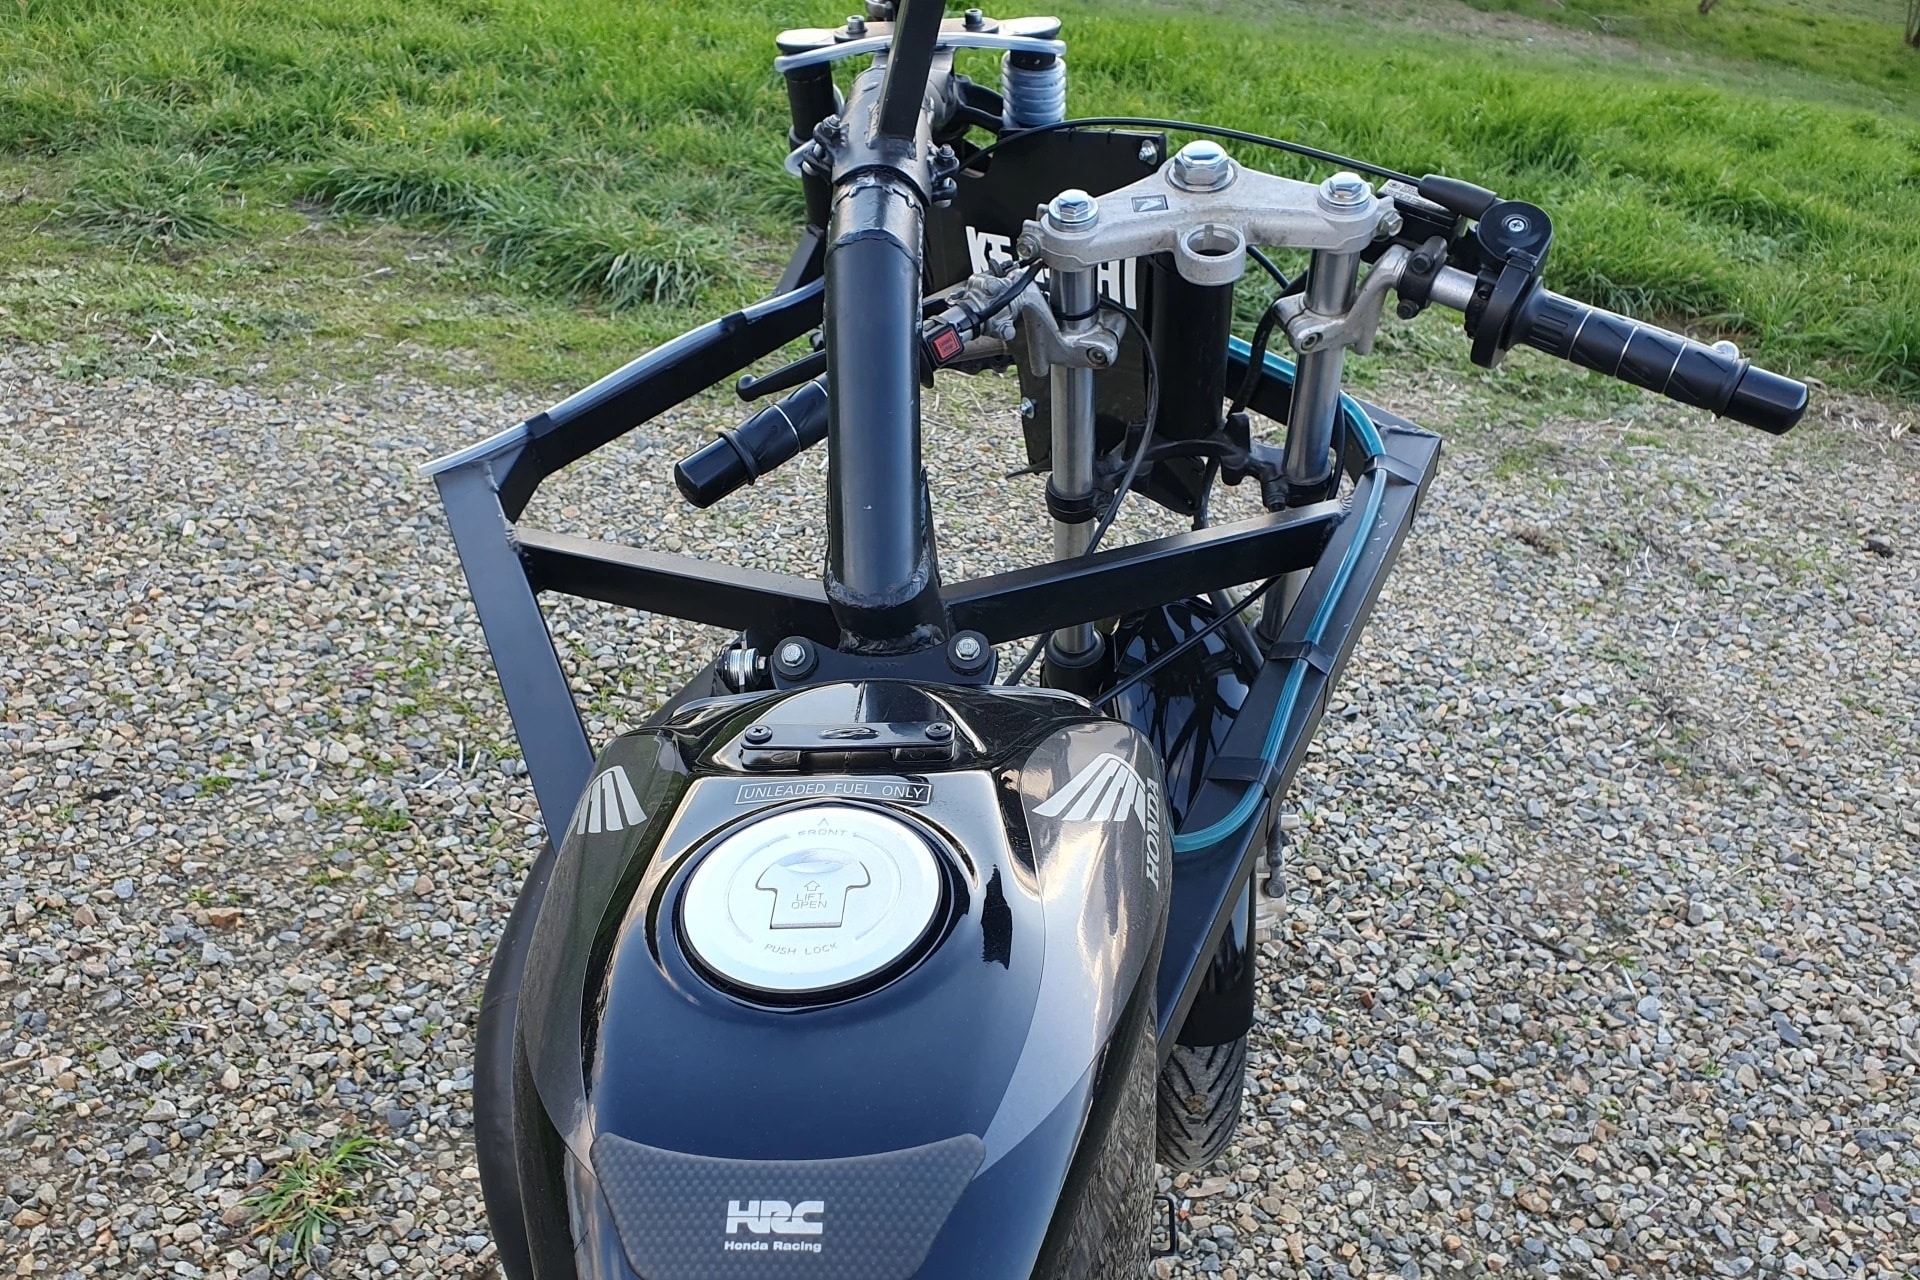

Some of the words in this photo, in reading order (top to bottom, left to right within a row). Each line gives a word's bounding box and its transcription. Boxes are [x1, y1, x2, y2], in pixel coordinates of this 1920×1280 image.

[744, 783, 826, 799] UNLEADED
[834, 783, 872, 795] FUEL
[881, 785, 925, 799] ONLY
[798, 828, 848, 837] FRONT
[1146, 777, 1160, 892] HONDA
[796, 893, 824, 901] LIFT
[791, 900, 827, 909] OPEN
[764, 943, 797, 955] PUSH
[804, 942, 838, 955] LOCK
[725, 1200, 825, 1234] HRC
[724, 1240, 769, 1251] Honda
[773, 1240, 822, 1253] Racing
